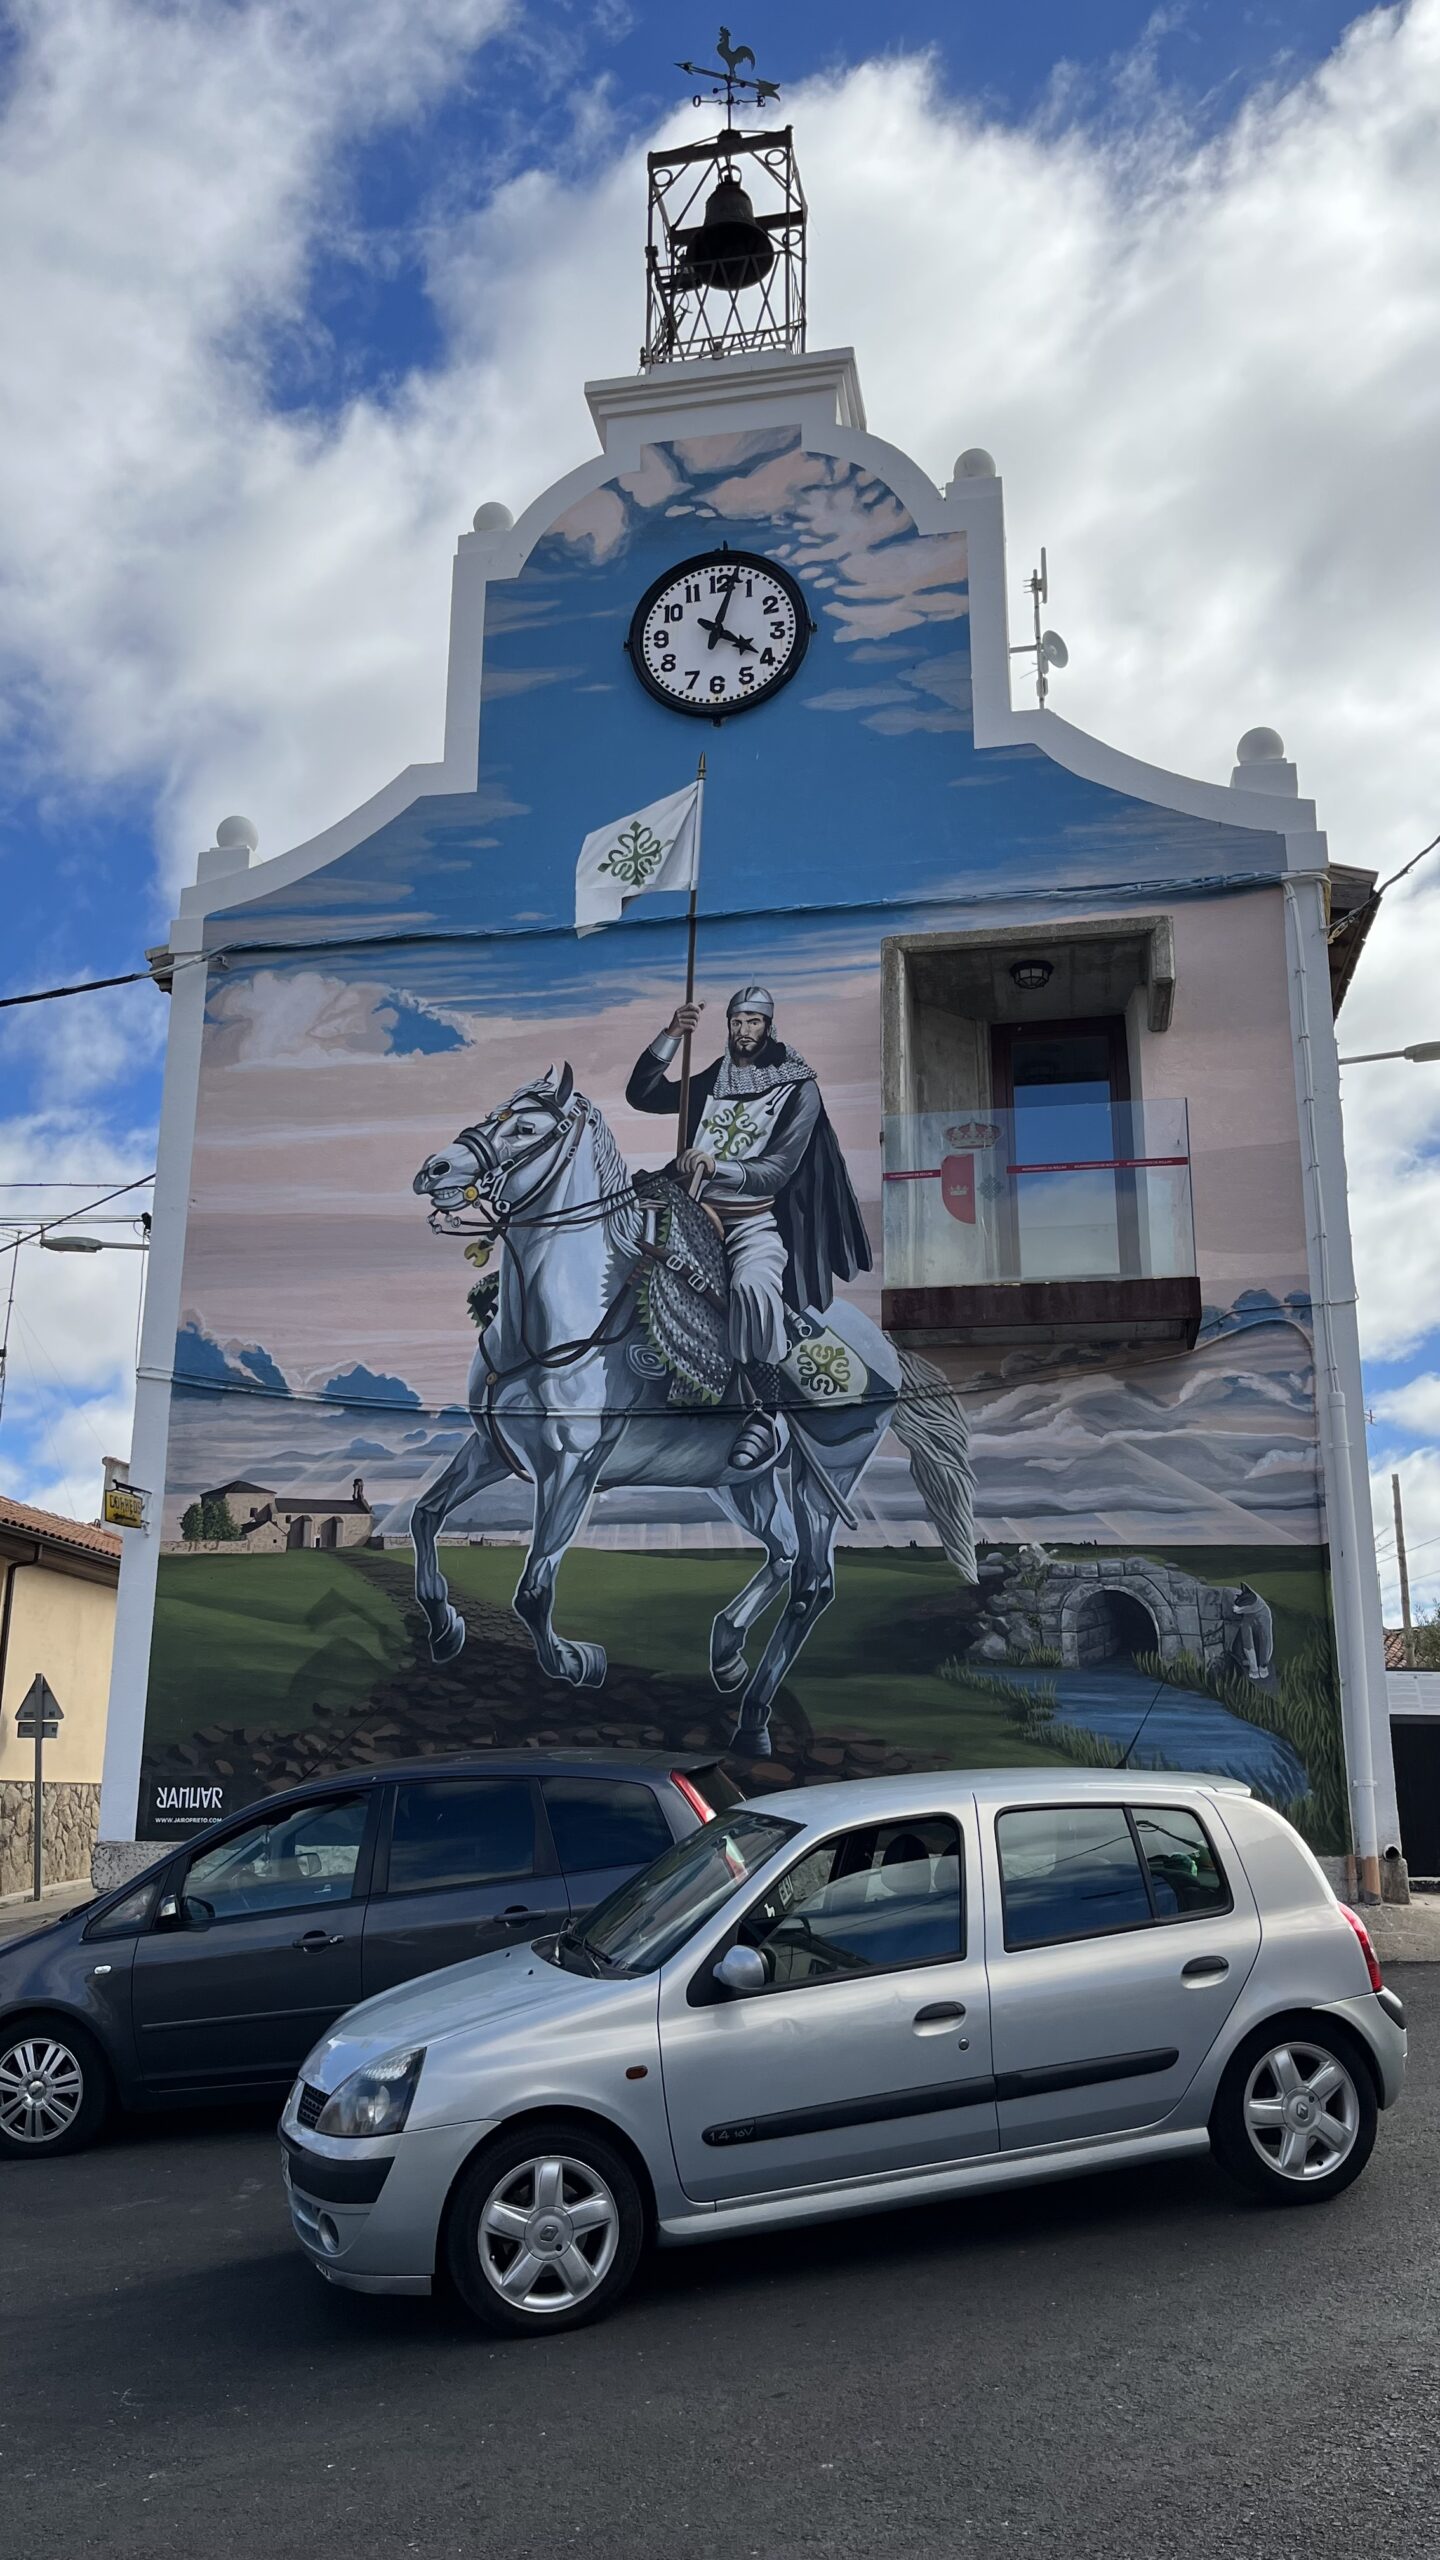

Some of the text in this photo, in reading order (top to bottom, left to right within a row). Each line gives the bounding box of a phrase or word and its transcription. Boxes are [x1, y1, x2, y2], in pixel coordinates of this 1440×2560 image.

[709, 574, 733, 594] 12
[745, 579, 753, 598] 1
[685, 584, 701, 604] 11
[664, 603, 683, 623] 10
[762, 595, 779, 615] 2
[653, 630, 669, 648] 9
[770, 621, 785, 640] 3
[661, 653, 676, 672] 8
[759, 647, 776, 666] 4
[684, 670, 700, 690] 7
[709, 675, 725, 694] 6
[738, 665, 754, 685] 5
